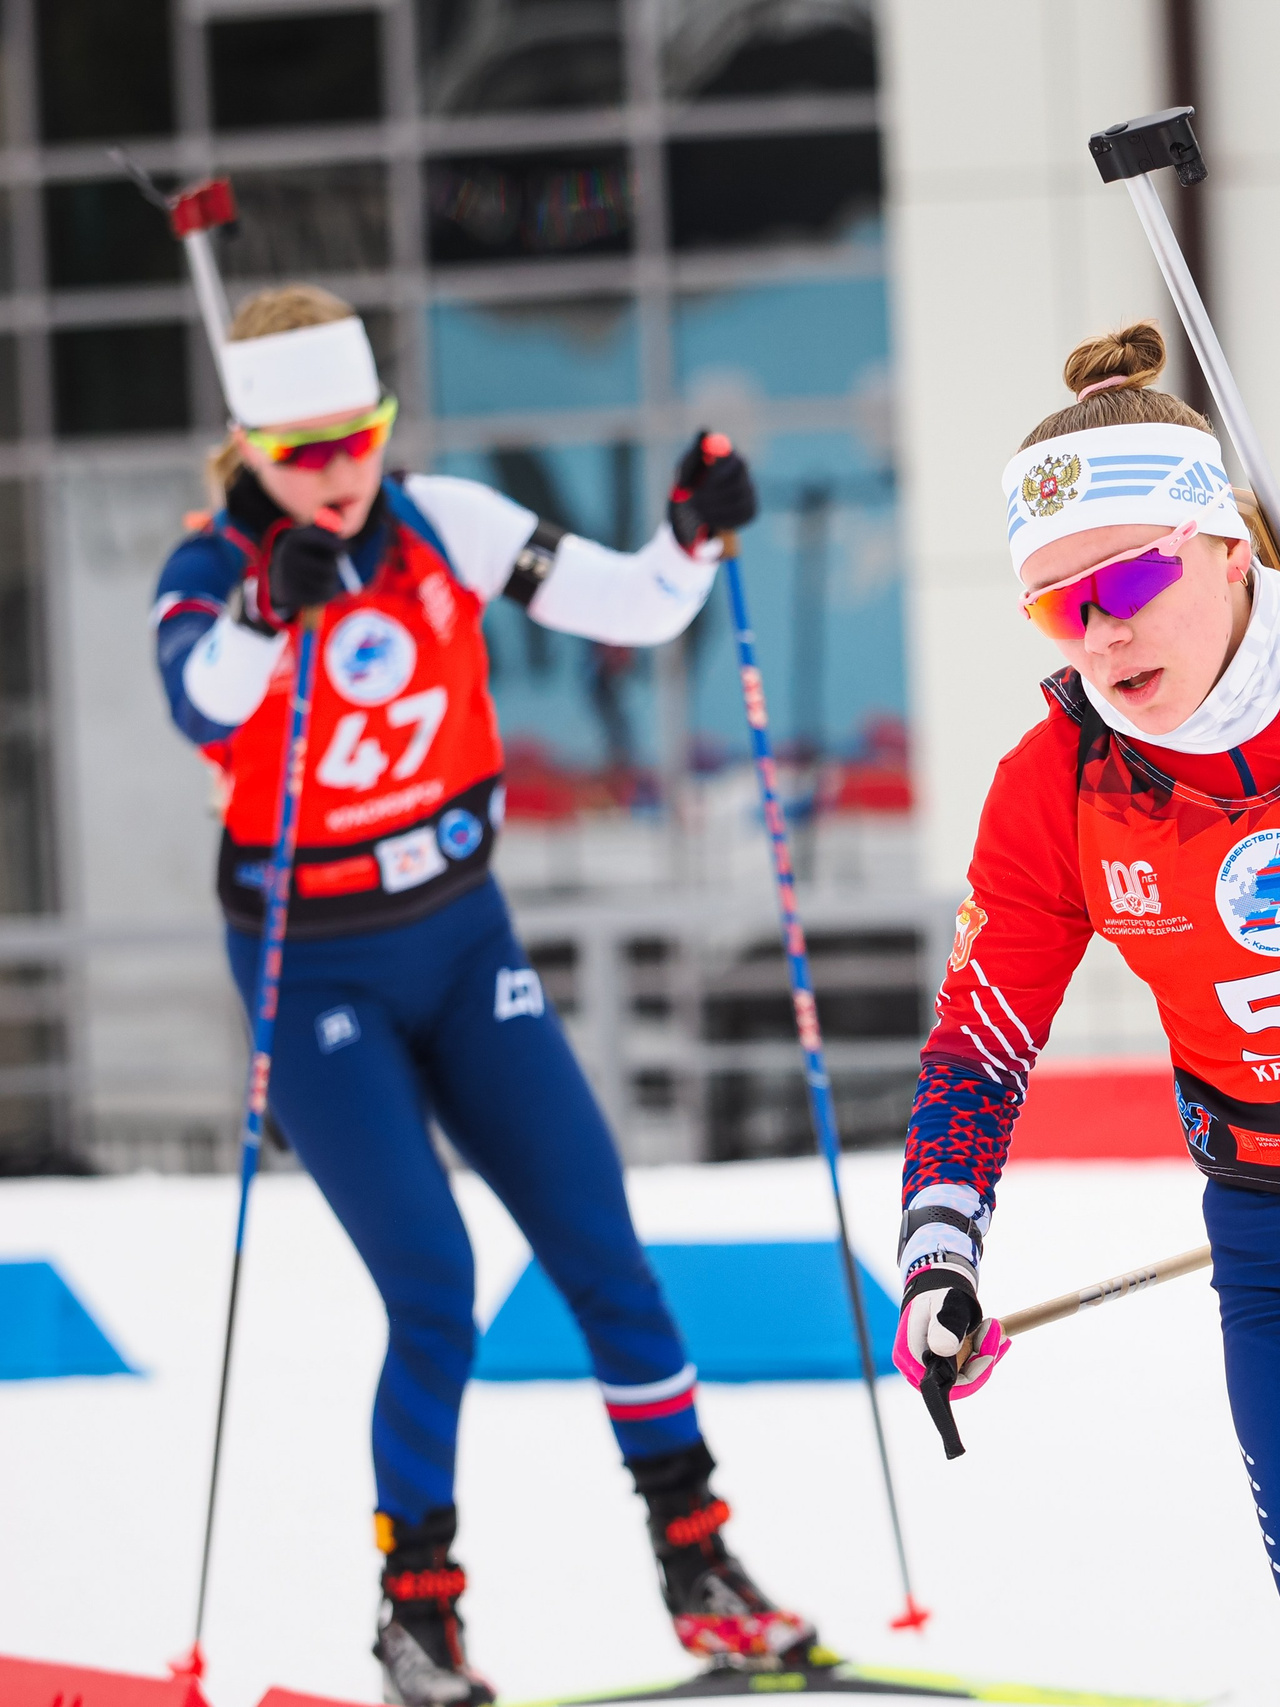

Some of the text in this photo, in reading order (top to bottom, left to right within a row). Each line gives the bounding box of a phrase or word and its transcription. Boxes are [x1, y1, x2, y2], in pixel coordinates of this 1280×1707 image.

[316, 685, 449, 792] 47
[1220, 833, 1273, 882] ПЕРВЕНСТВО
[1102, 923, 1194, 936] РОССИЙСКОЙ ФЕДЕРАЦИИ
[1104, 915, 1188, 928] МИНИСТЕРСТВО СПОРТА
